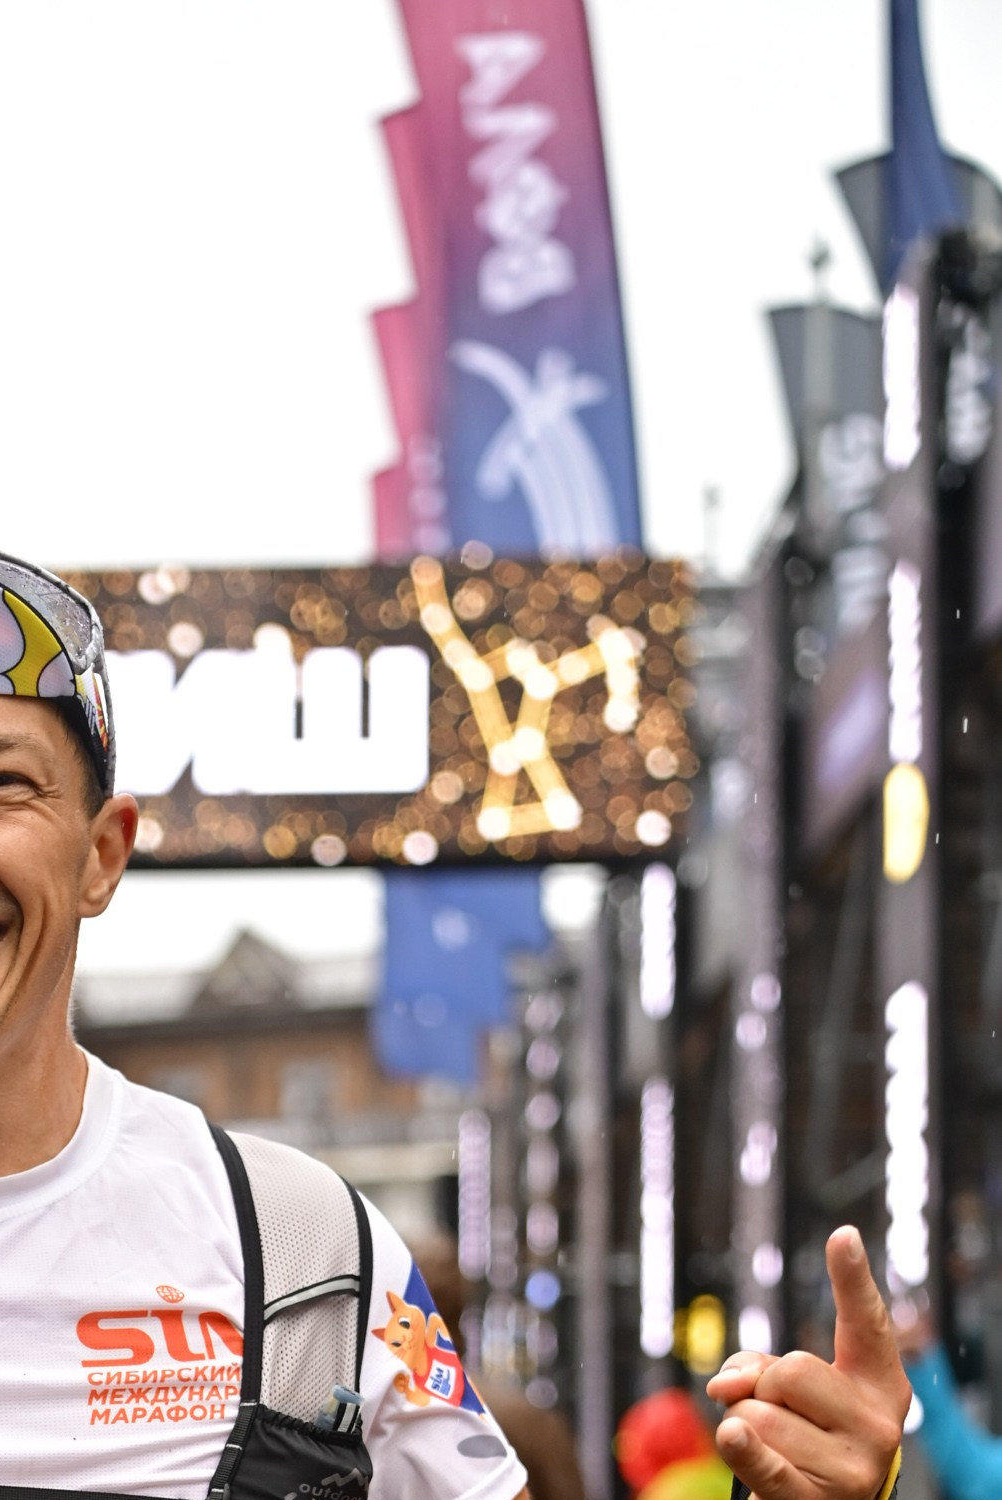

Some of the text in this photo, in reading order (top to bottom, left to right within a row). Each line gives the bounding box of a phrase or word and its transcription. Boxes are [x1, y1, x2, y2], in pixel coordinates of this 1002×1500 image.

[87, 1362, 242, 1386] СИБИРСКИЙ
[87, 1384, 242, 1407] МЕЖДУНАР
[89, 1403, 226, 1425] МАРАФОН
